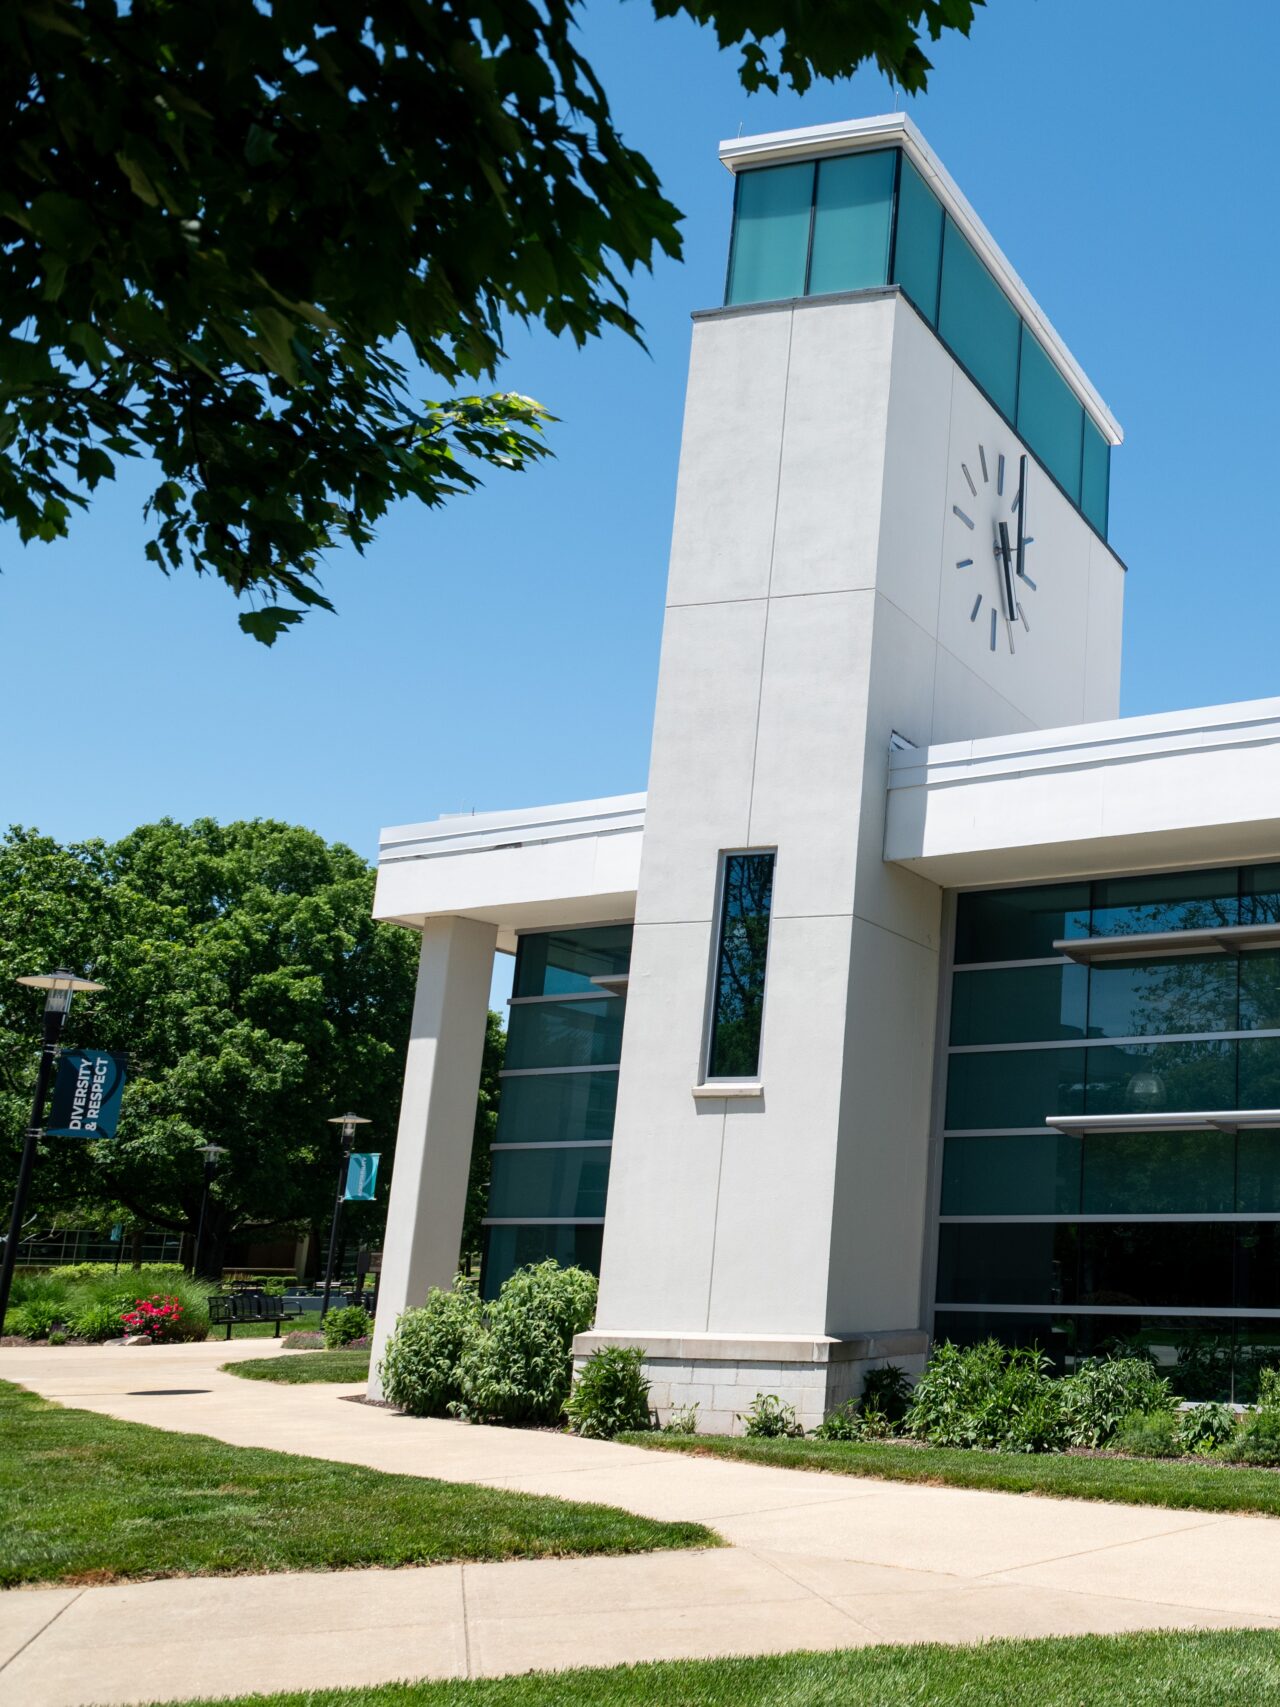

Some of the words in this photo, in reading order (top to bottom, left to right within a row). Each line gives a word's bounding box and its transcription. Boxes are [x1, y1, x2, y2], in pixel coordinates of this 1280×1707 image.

[68, 1058, 93, 1130] DIVERSITY
[86, 1057, 109, 1119] RESPECT
[84, 1121, 97, 1131] &
